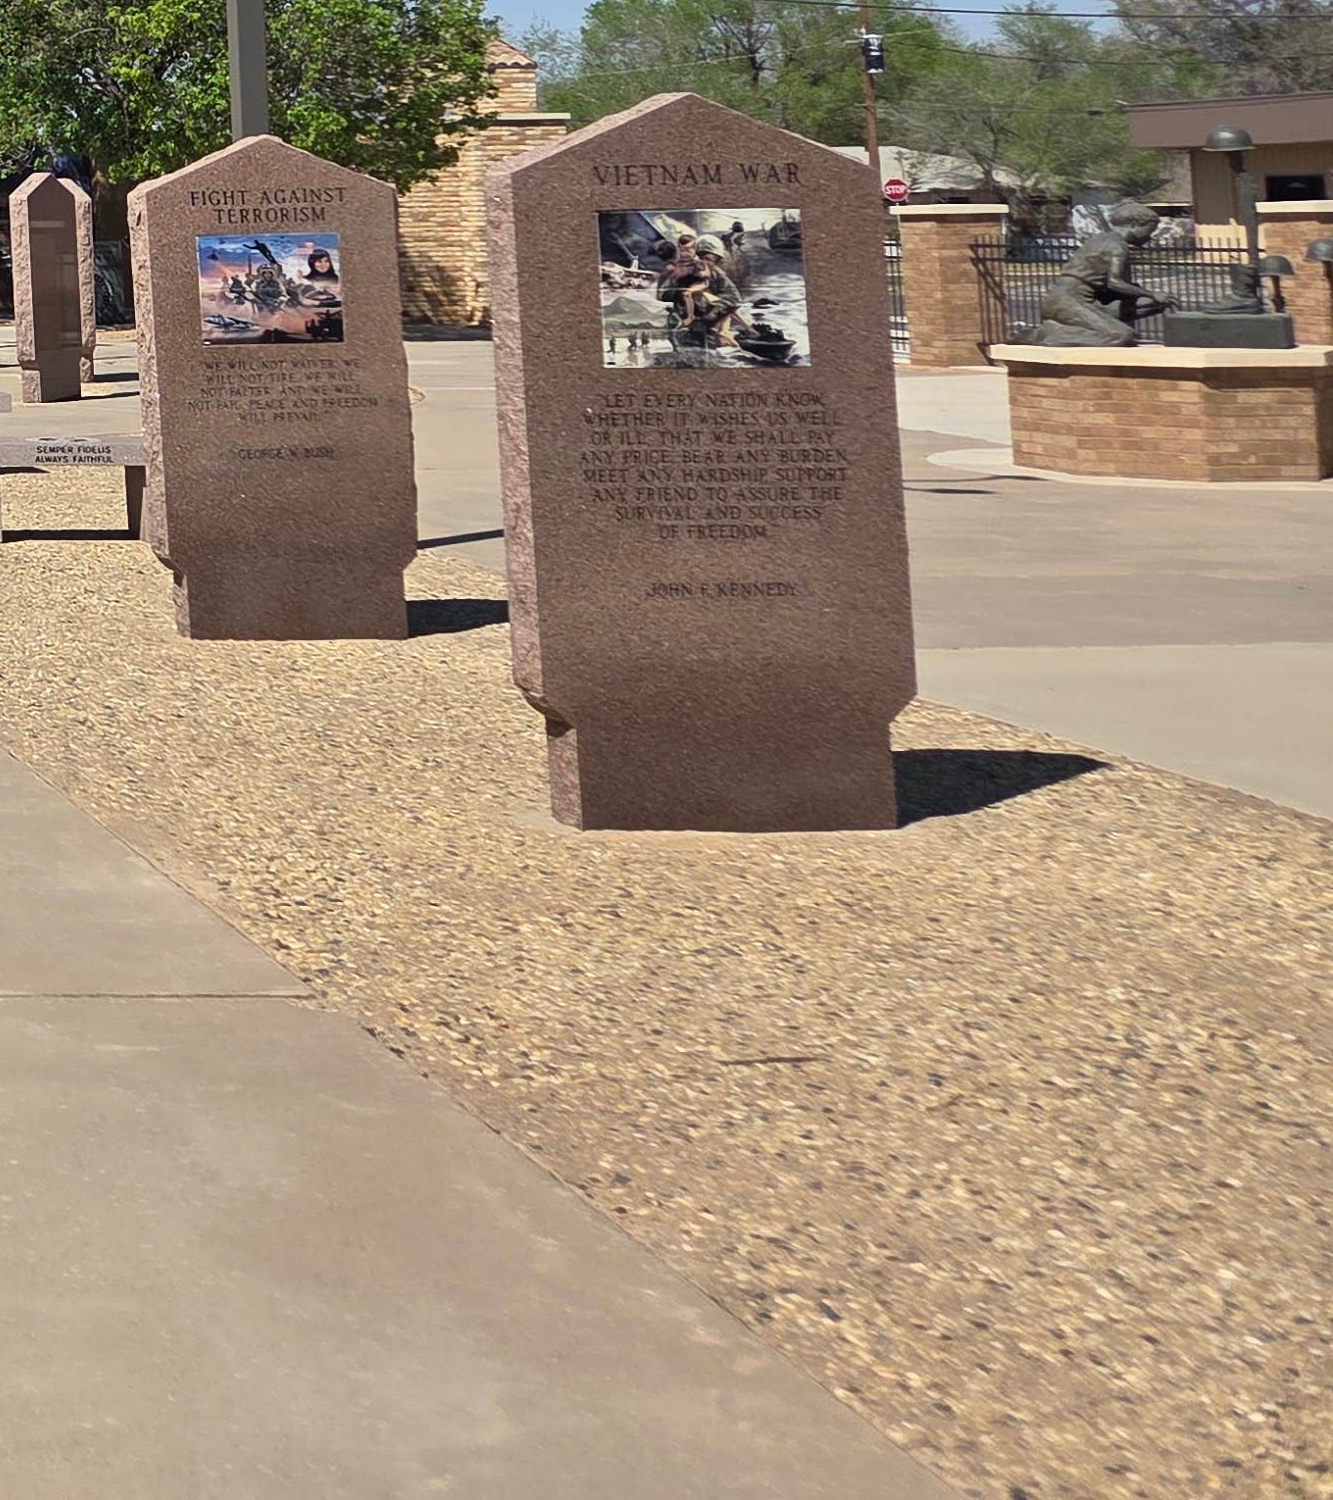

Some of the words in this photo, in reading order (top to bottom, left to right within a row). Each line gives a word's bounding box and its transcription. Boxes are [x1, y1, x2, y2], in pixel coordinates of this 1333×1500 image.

[593, 163, 722, 187] VIETNAM
[739, 163, 805, 187] WAR
[190, 190, 248, 206] FIGHT
[261, 188, 347, 205] AGAINST
[886, 186, 907, 195] STOP
[214, 207, 326, 224] TERRORISM
[37, 446, 73, 454] SEMPER
[77, 446, 111, 454] FIDELIS
[646, 583, 693, 597] JOHN
[716, 582, 797, 597] KENNEDY
